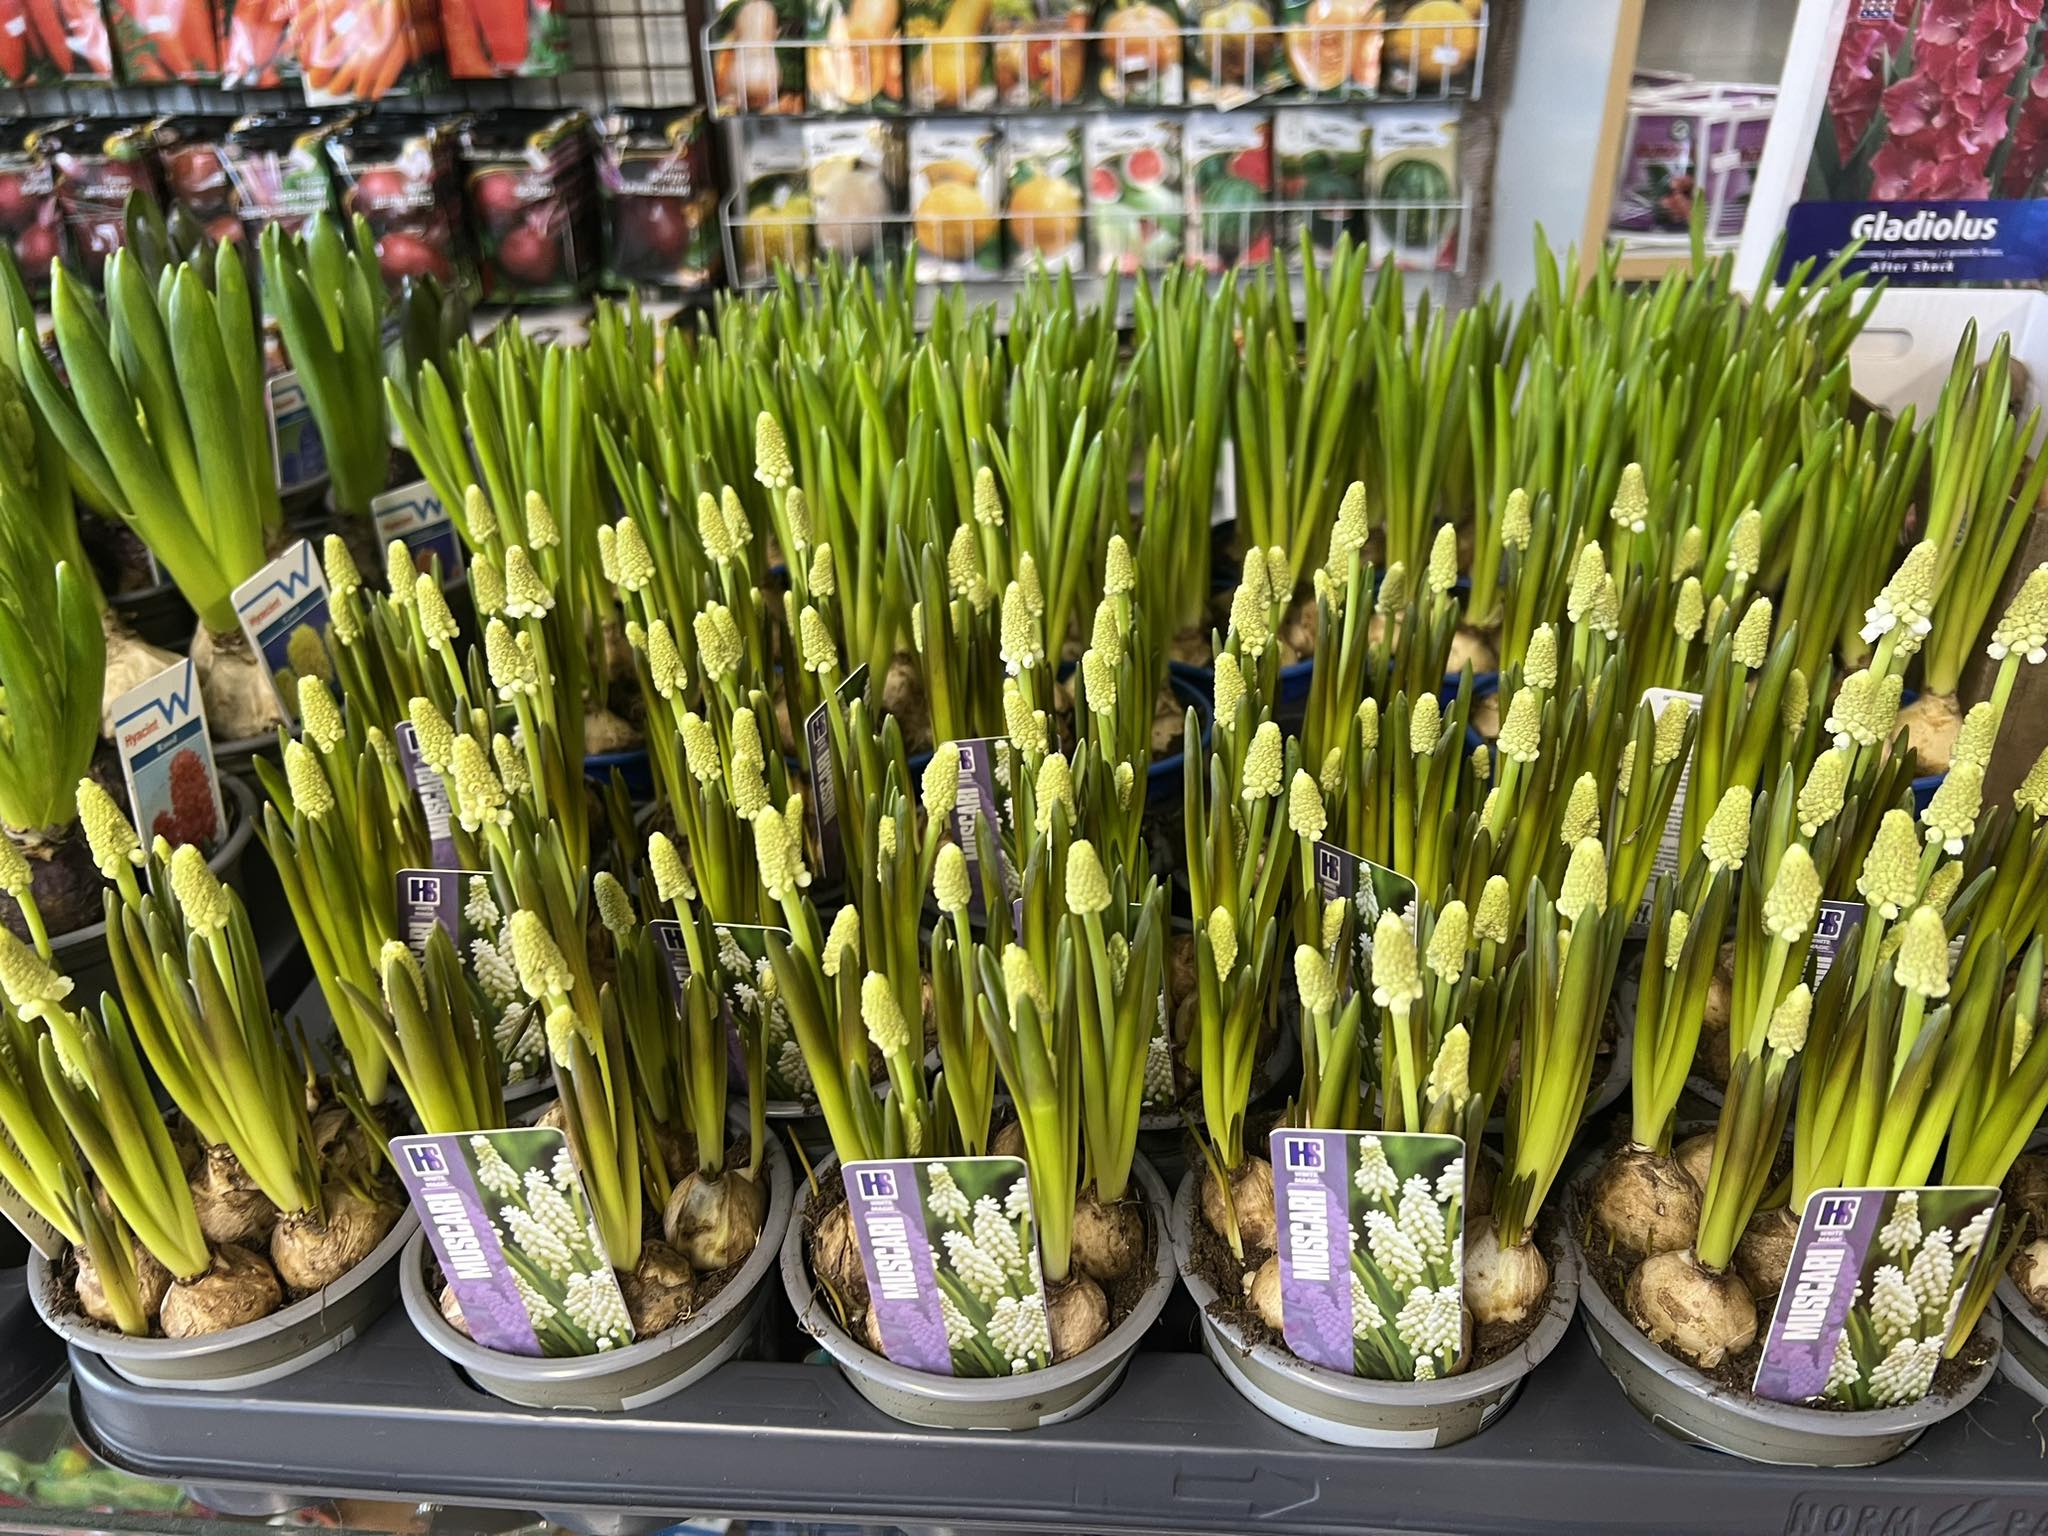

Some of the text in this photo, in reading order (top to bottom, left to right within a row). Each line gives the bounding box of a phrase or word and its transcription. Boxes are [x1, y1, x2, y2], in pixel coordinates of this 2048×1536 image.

[1851, 210, 1999, 242] Gladiolus
[1870, 260, 1954, 273] After Shock
[956, 787, 981, 861] MUSCARI
[1321, 851, 1339, 882] HS
[410, 879, 438, 903] HS
[407, 1146, 445, 1173] HS
[1289, 1141, 1322, 1168] HS
[860, 1172, 894, 1197] HS
[1819, 1200, 1857, 1226] HS
[422, 1192, 493, 1280] MUSCARI
[1287, 1189, 1331, 1281] MUSCARI
[865, 1217, 920, 1300] MUSCARI
[1781, 1249, 1846, 1341] MUSCARI
